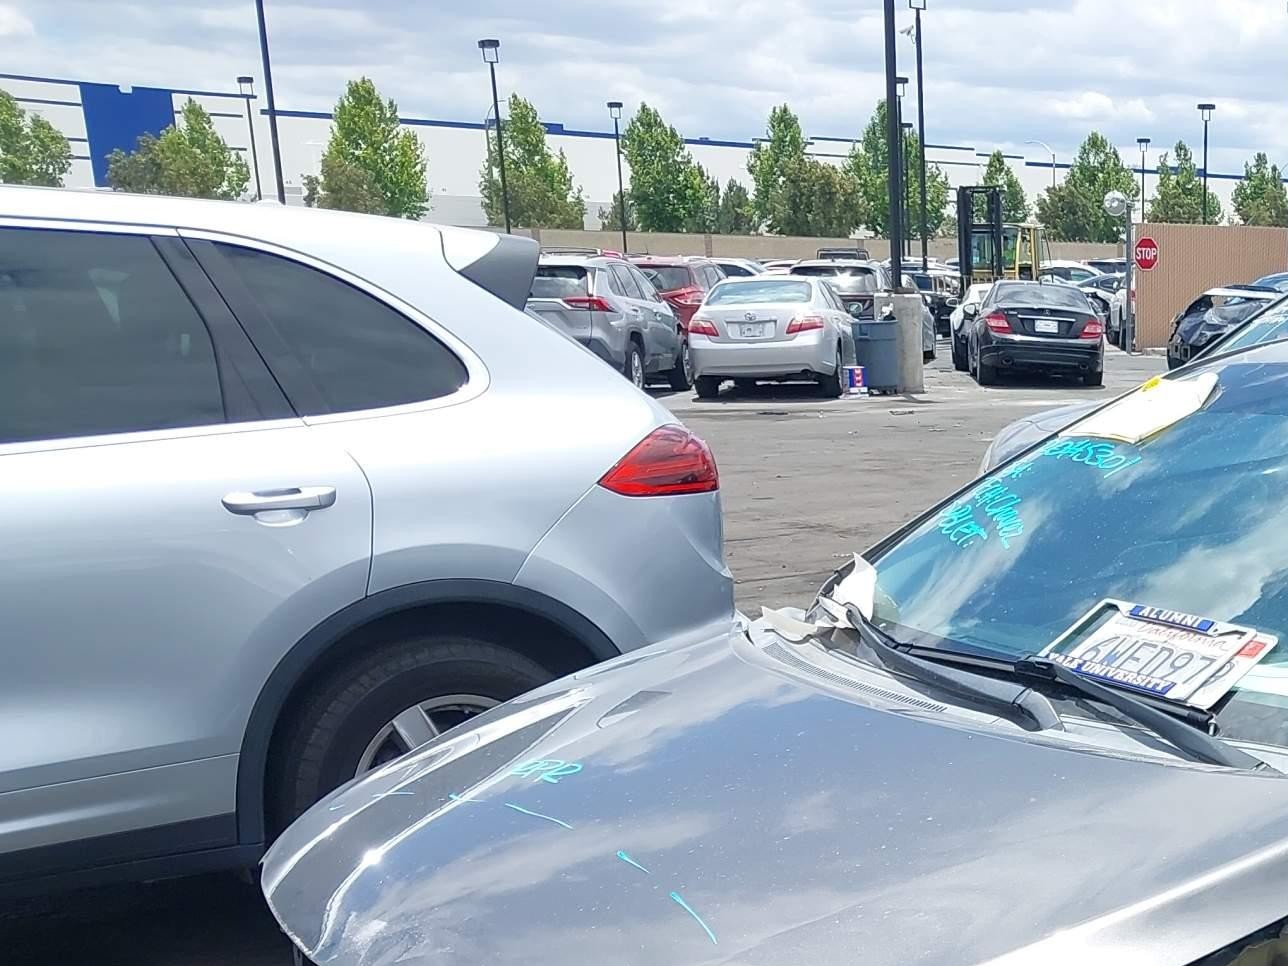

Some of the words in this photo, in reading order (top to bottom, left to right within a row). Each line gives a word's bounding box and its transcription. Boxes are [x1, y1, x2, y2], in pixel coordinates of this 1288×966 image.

[1136, 247, 1157, 260] STOP
[1140, 608, 1202, 626] ALUMNI
[1082, 660, 1173, 691] UNIVERSITY
